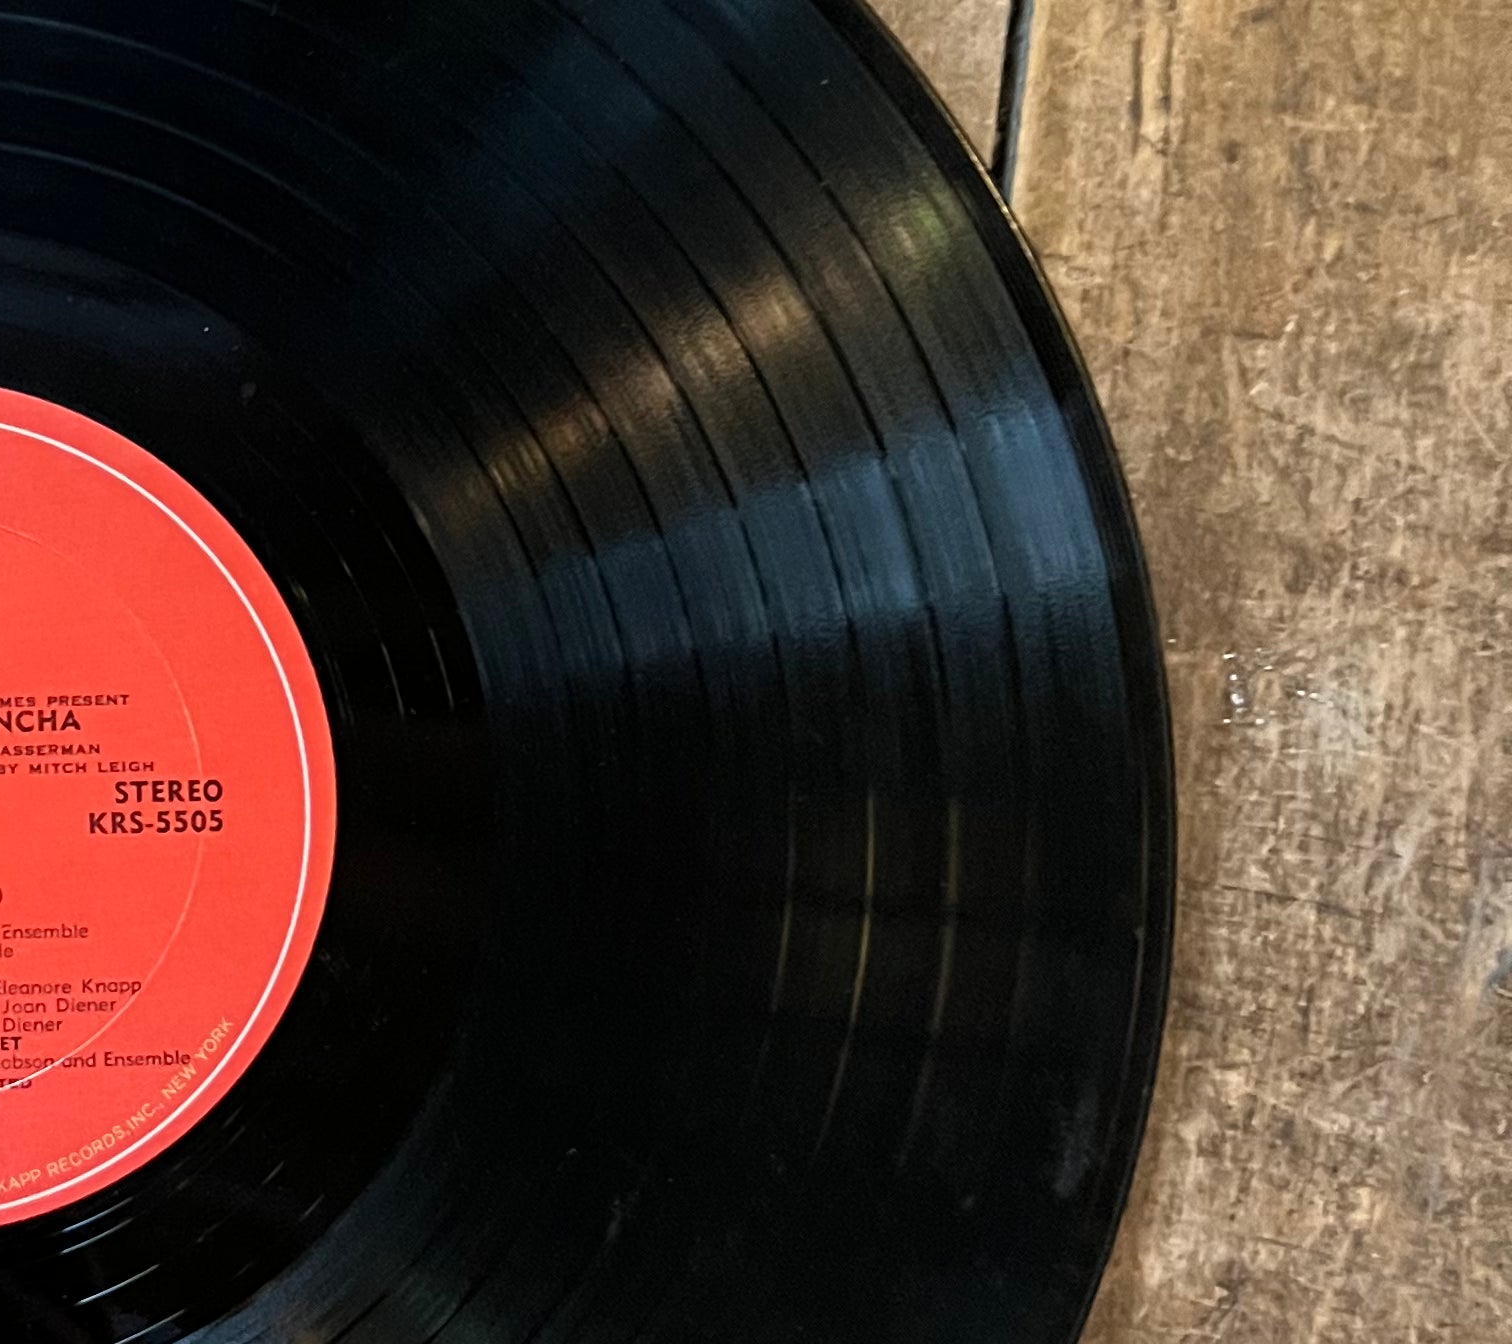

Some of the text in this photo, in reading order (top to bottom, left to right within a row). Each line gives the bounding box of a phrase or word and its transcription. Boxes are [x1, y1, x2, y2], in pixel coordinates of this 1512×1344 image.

[47, 694, 129, 707] PRESENT
[29, 763, 86, 774] MITCH
[98, 762, 153, 773] LEIGH
[115, 780, 223, 804] STEREO
[89, 810, 223, 834] KRS-5505
[82, 979, 141, 995] Knapp
[4, 1000, 46, 1013] Joan
[57, 998, 116, 1012] Diener
[3, 1018, 62, 1032] Diener
[59, 1053, 96, 1068] and
[104, 1050, 190, 1066] Ensemble
[161, 1063, 197, 1099] NEW
[194, 1017, 234, 1060] YORK
